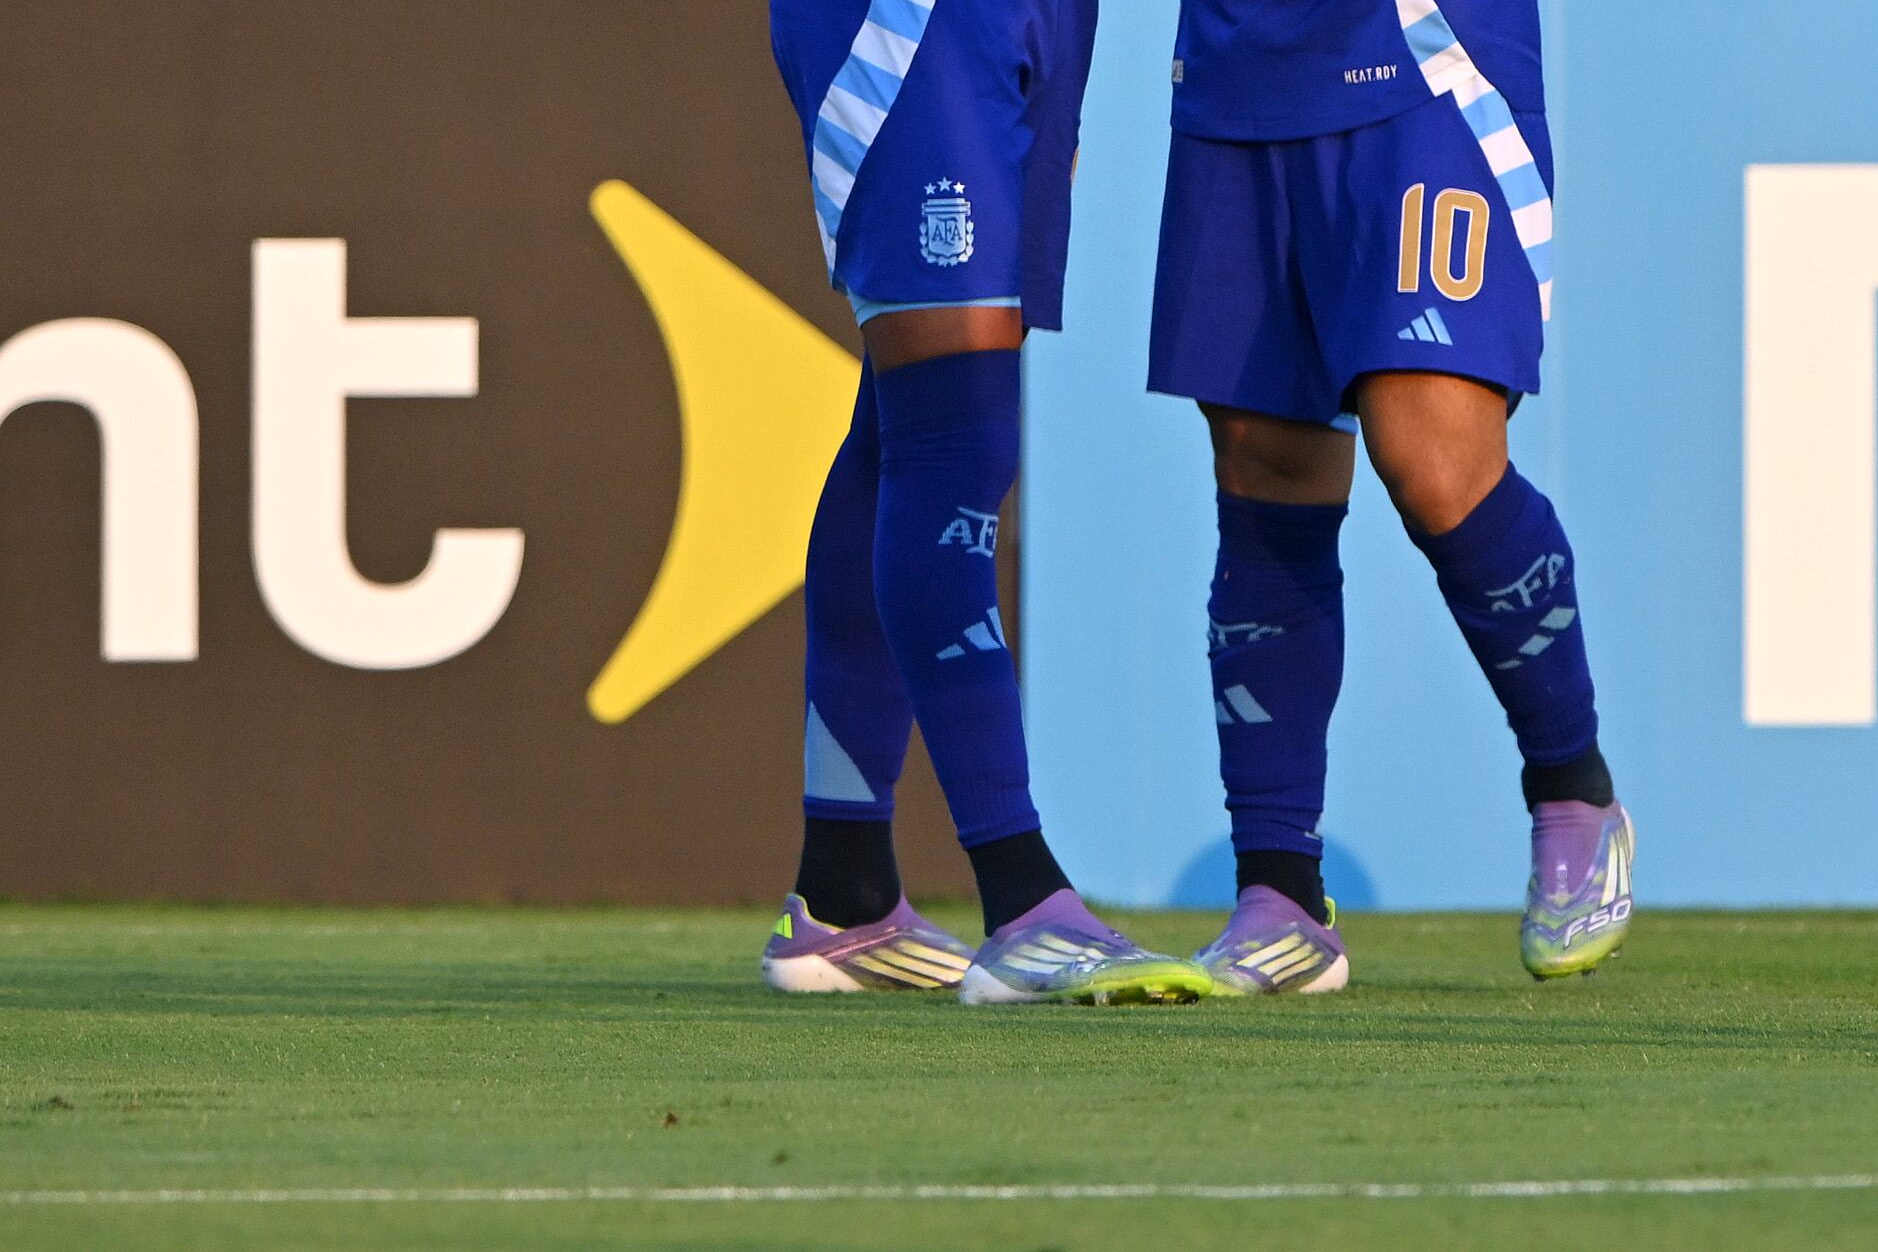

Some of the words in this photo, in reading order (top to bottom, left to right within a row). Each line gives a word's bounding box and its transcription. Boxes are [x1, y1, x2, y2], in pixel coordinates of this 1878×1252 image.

[1344, 64, 1398, 85] HEAT.RDY
[931, 216, 963, 246] AFA
[1397, 182, 1490, 302] 10
[938, 506, 999, 558] AF
[1563, 899, 1632, 948] F50
